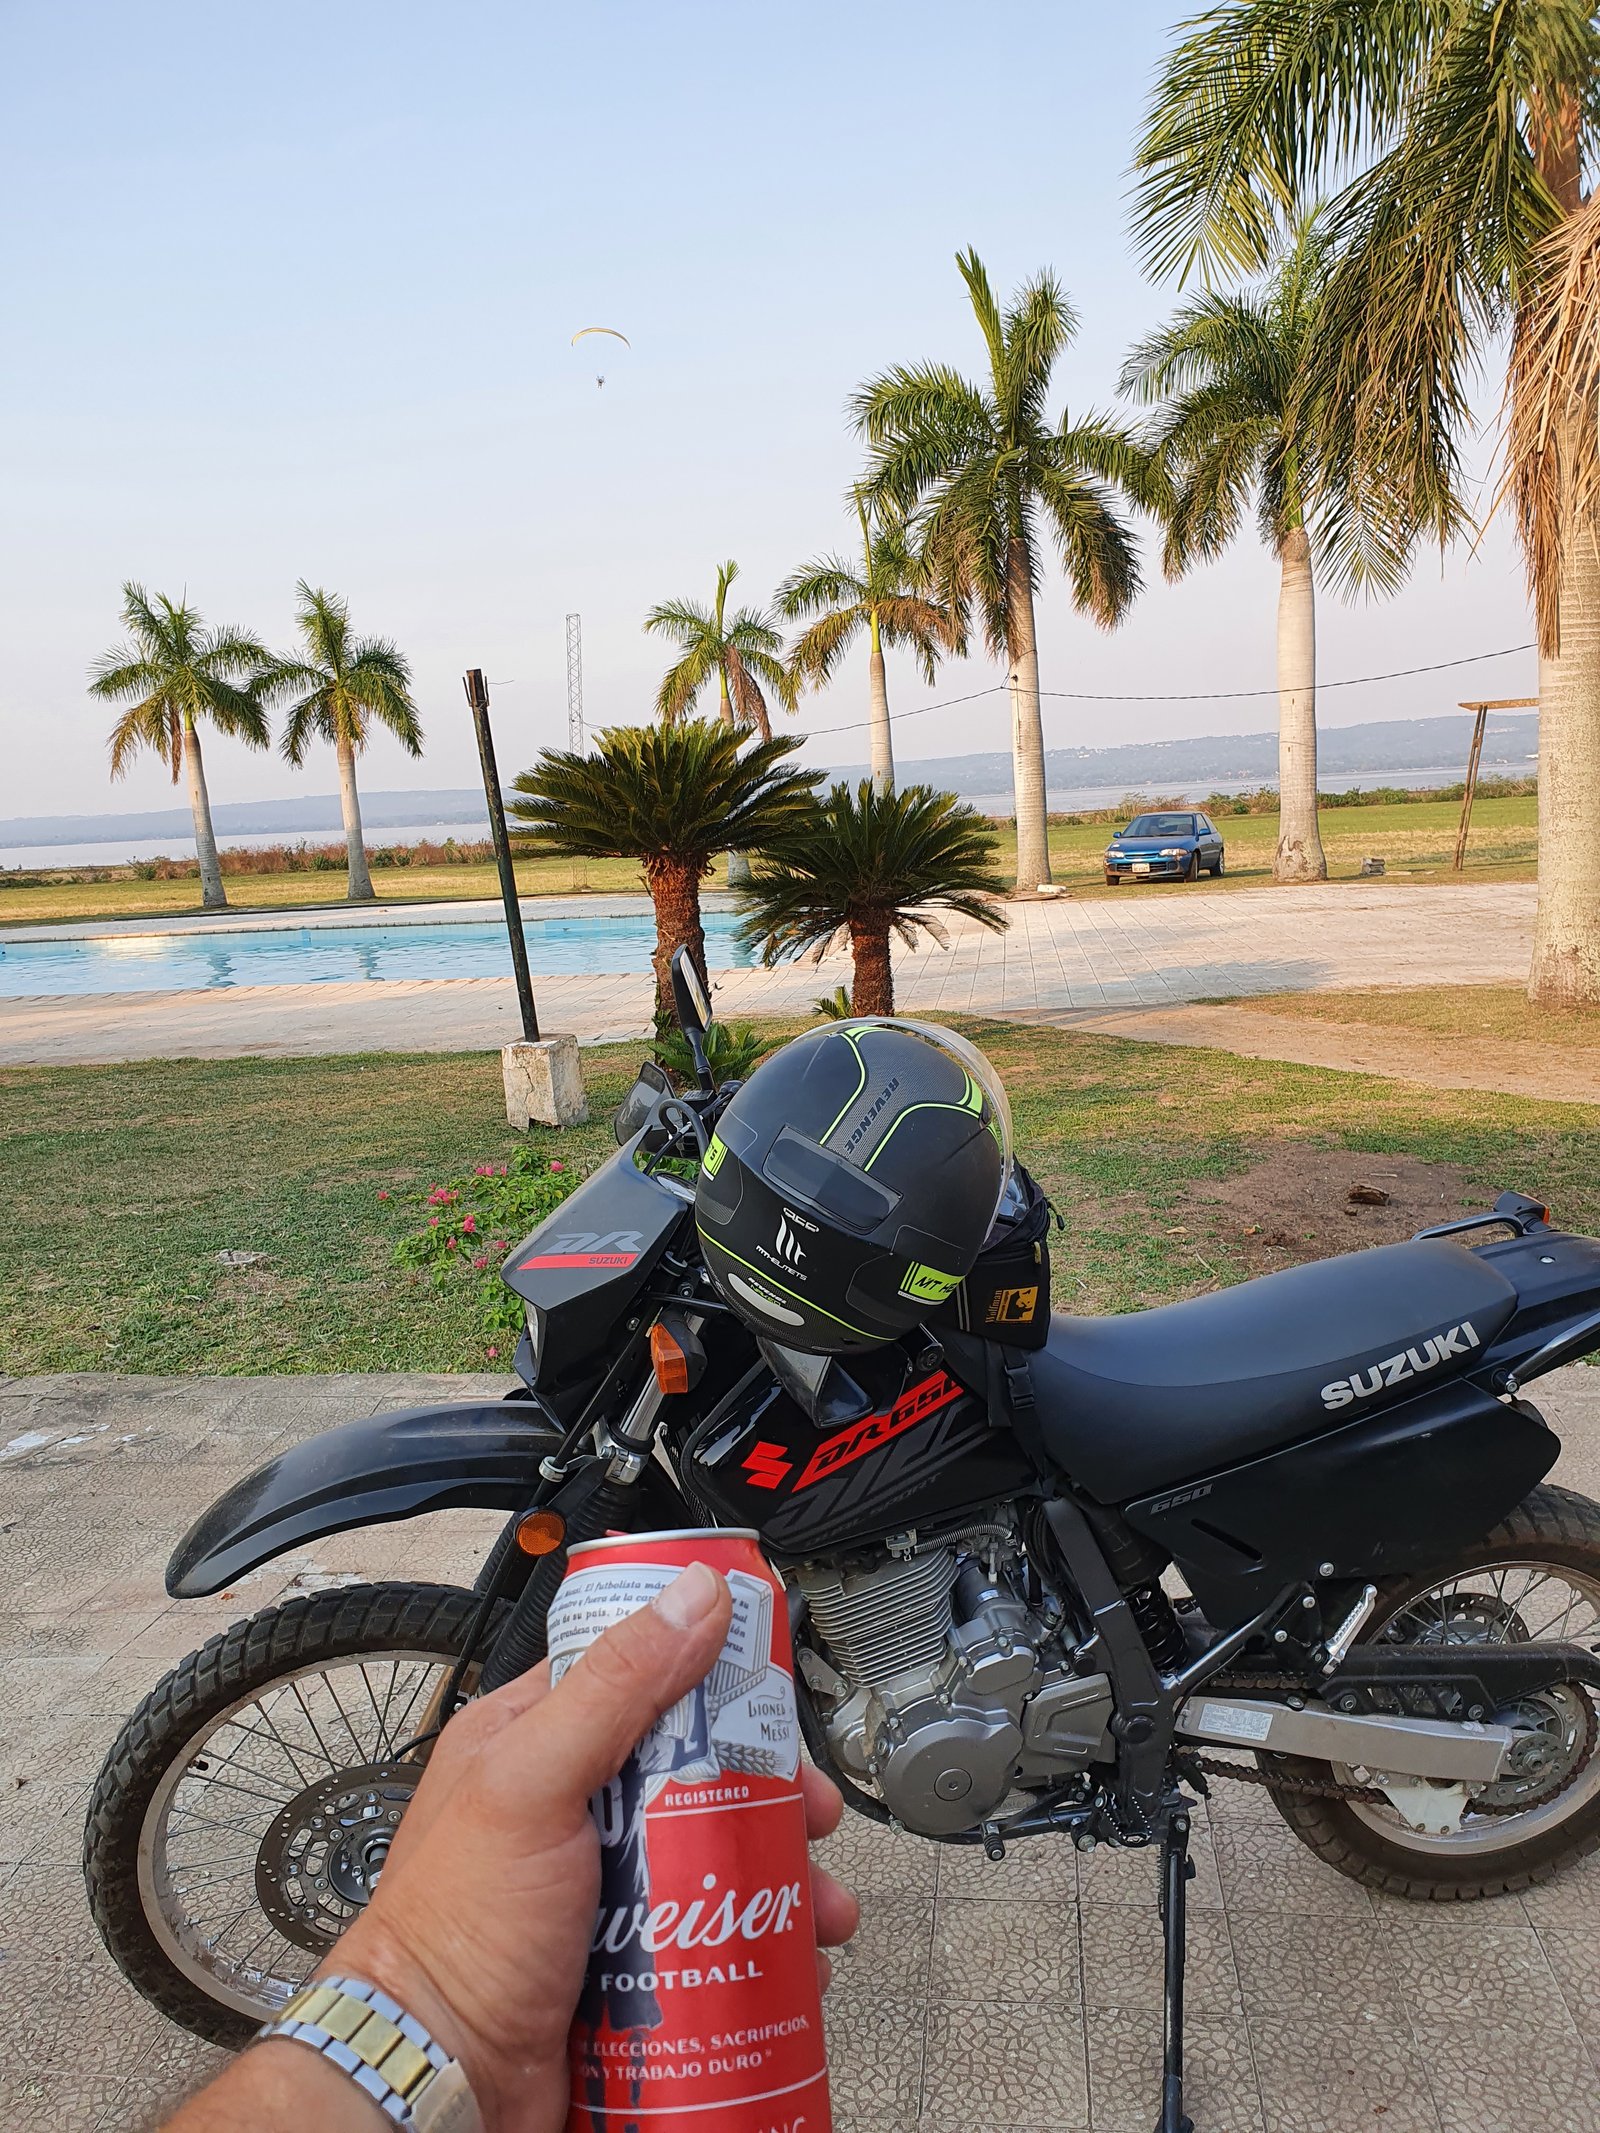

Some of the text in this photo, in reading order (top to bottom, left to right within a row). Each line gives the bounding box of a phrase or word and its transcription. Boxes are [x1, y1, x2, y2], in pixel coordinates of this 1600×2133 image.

[844, 1077, 900, 1154] REVENGE
[541, 1230, 645, 1255] DR
[588, 1256, 629, 1265] SUZUKI
[915, 1276, 943, 1291] MT
[985, 1290, 1003, 1323] Wolfman
[1320, 1321, 1481, 1410] SUZUKI
[1149, 1484, 1213, 1515] 650
[595, 1580, 641, 1592] futbolista
[609, 1593, 621, 1601] de
[623, 1593, 633, 1601] la
[739, 1600, 750, 1609] su
[748, 1700, 786, 1718] LIONEL
[760, 1721, 790, 1742] MESSI
[665, 1786, 749, 1807] REGISTERED
[600, 1960, 764, 1993] FOOTBALL
[615, 2061, 702, 2081] TRABAJO
